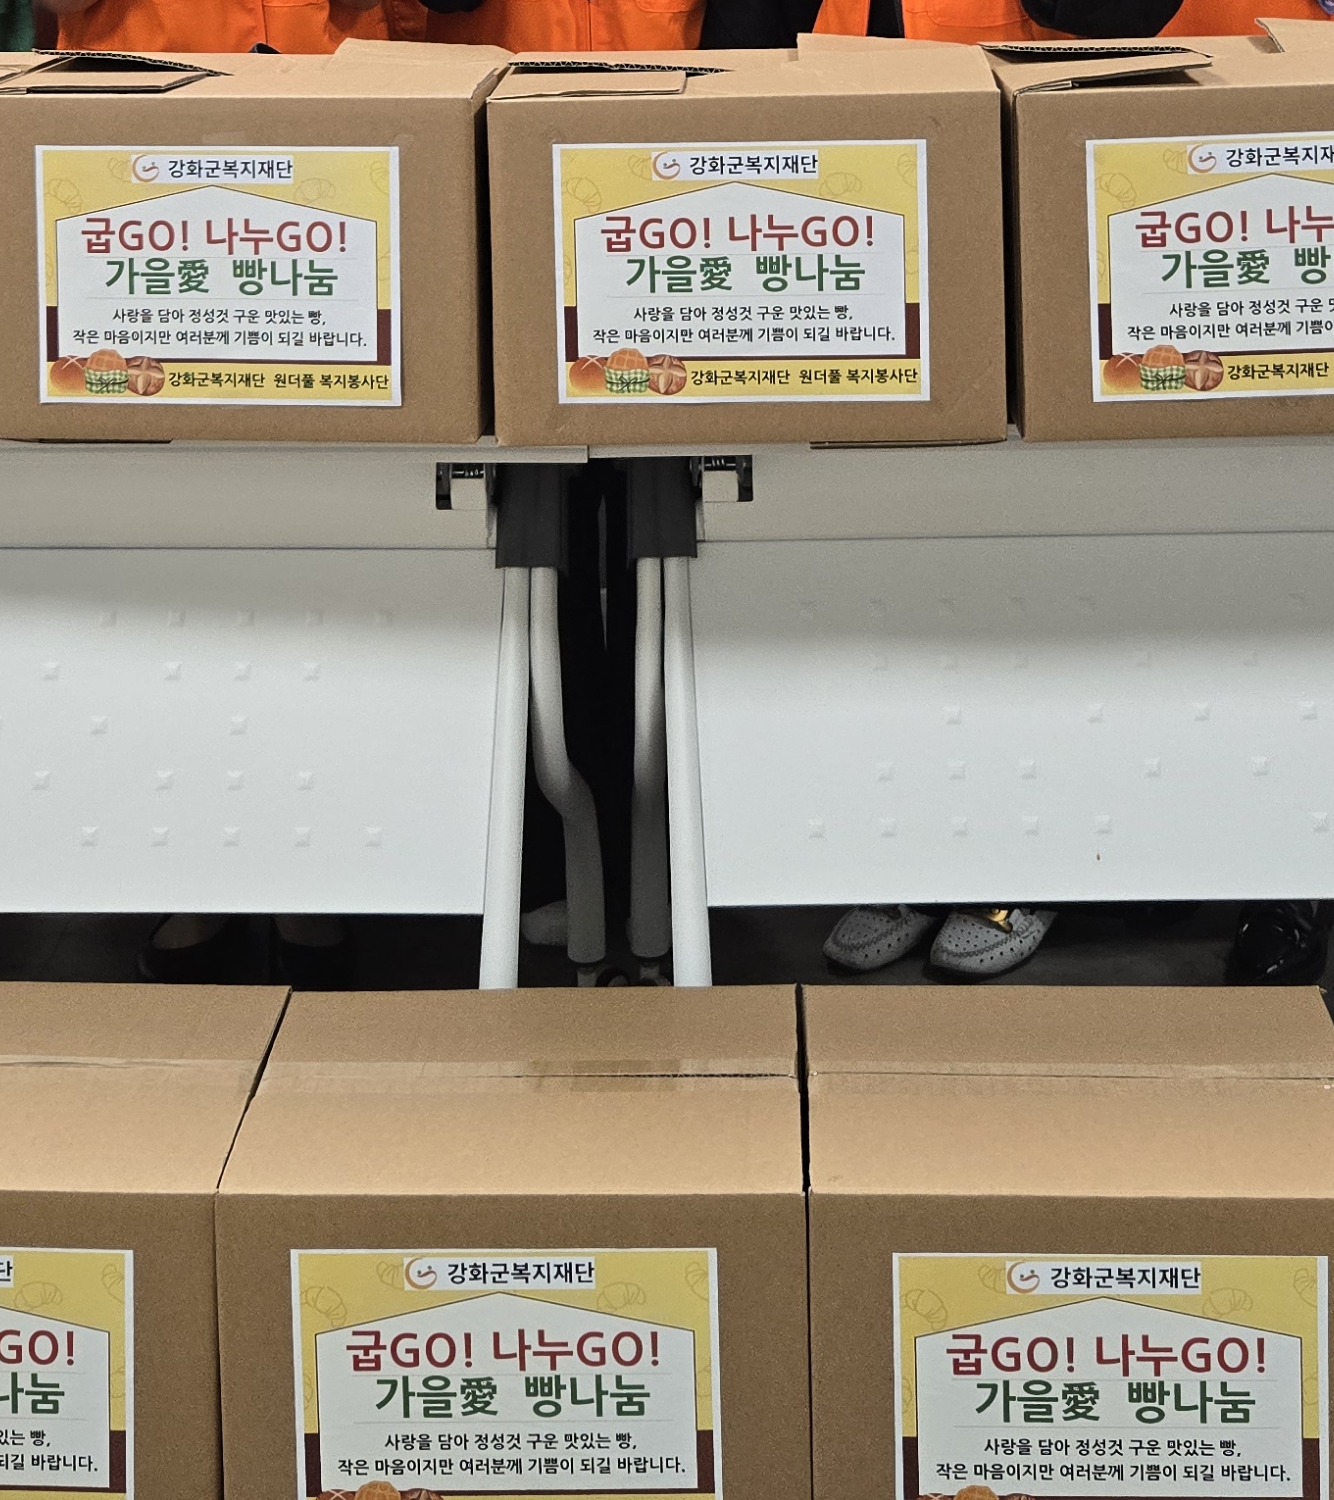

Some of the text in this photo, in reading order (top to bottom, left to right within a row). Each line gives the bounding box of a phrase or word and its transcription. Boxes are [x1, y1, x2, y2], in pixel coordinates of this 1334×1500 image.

[168, 157, 293, 180] 강화군복지재단
[690, 154, 818, 174] 강화군복지재단
[81, 217, 347, 257] 굽GO! 나누GO!
[601, 214, 874, 252] 굽GO! 나누GO!
[1135, 208, 1248, 248] 굽GO!
[106, 256, 338, 298] 가을愛 빵나눔
[626, 254, 865, 293] 가을愛 빵나눔
[1161, 248, 1270, 289] 가을愛
[633, 306, 673, 321] 사랑을
[679, 306, 706, 321] 담아
[756, 306, 784, 321] 구운
[789, 306, 830, 320] 맛있는
[593, 326, 895, 344] 작은 마음이지만 여러분께 기쁨이 되길 바랍니다.
[168, 372, 389, 390] 강화군복지재단 원더풀 복지봉사단
[691, 368, 918, 386] 강화군복지재단 원더풀 복지봉사단
[1228, 363, 1329, 382] 강화군복지재단
[448, 1260, 595, 1284] 강화군복지재단
[1051, 1264, 1201, 1290] 강화군복지재단
[346, 1329, 660, 1372] 굽GO! 나누GO!
[946, 1333, 1266, 1378] 굽GO! 나누GO!
[375, 1374, 651, 1419] 가을愛 빵나눔
[975, 1379, 1256, 1425] 가을愛 빵나눔
[385, 1433, 431, 1450] 사랑을
[437, 1433, 468, 1450] 담아
[526, 1433, 558, 1450] 구운
[564, 1433, 610, 1450] 맛있는
[984, 1438, 1031, 1456] 사랑을
[1038, 1438, 1069, 1456] 담아
[1128, 1439, 1161, 1457] 구운
[1167, 1440, 1214, 1457] 맛있는
[30, 1453, 98, 1473] 바랍니다.
[338, 1456, 686, 1476] 작은 마음이지만 여러분께 기쁨이 되길 바랍니다.
[936, 1462, 1291, 1482] 작은 마음이지만 여러분께 기쁨이 되길 바랍니다.
